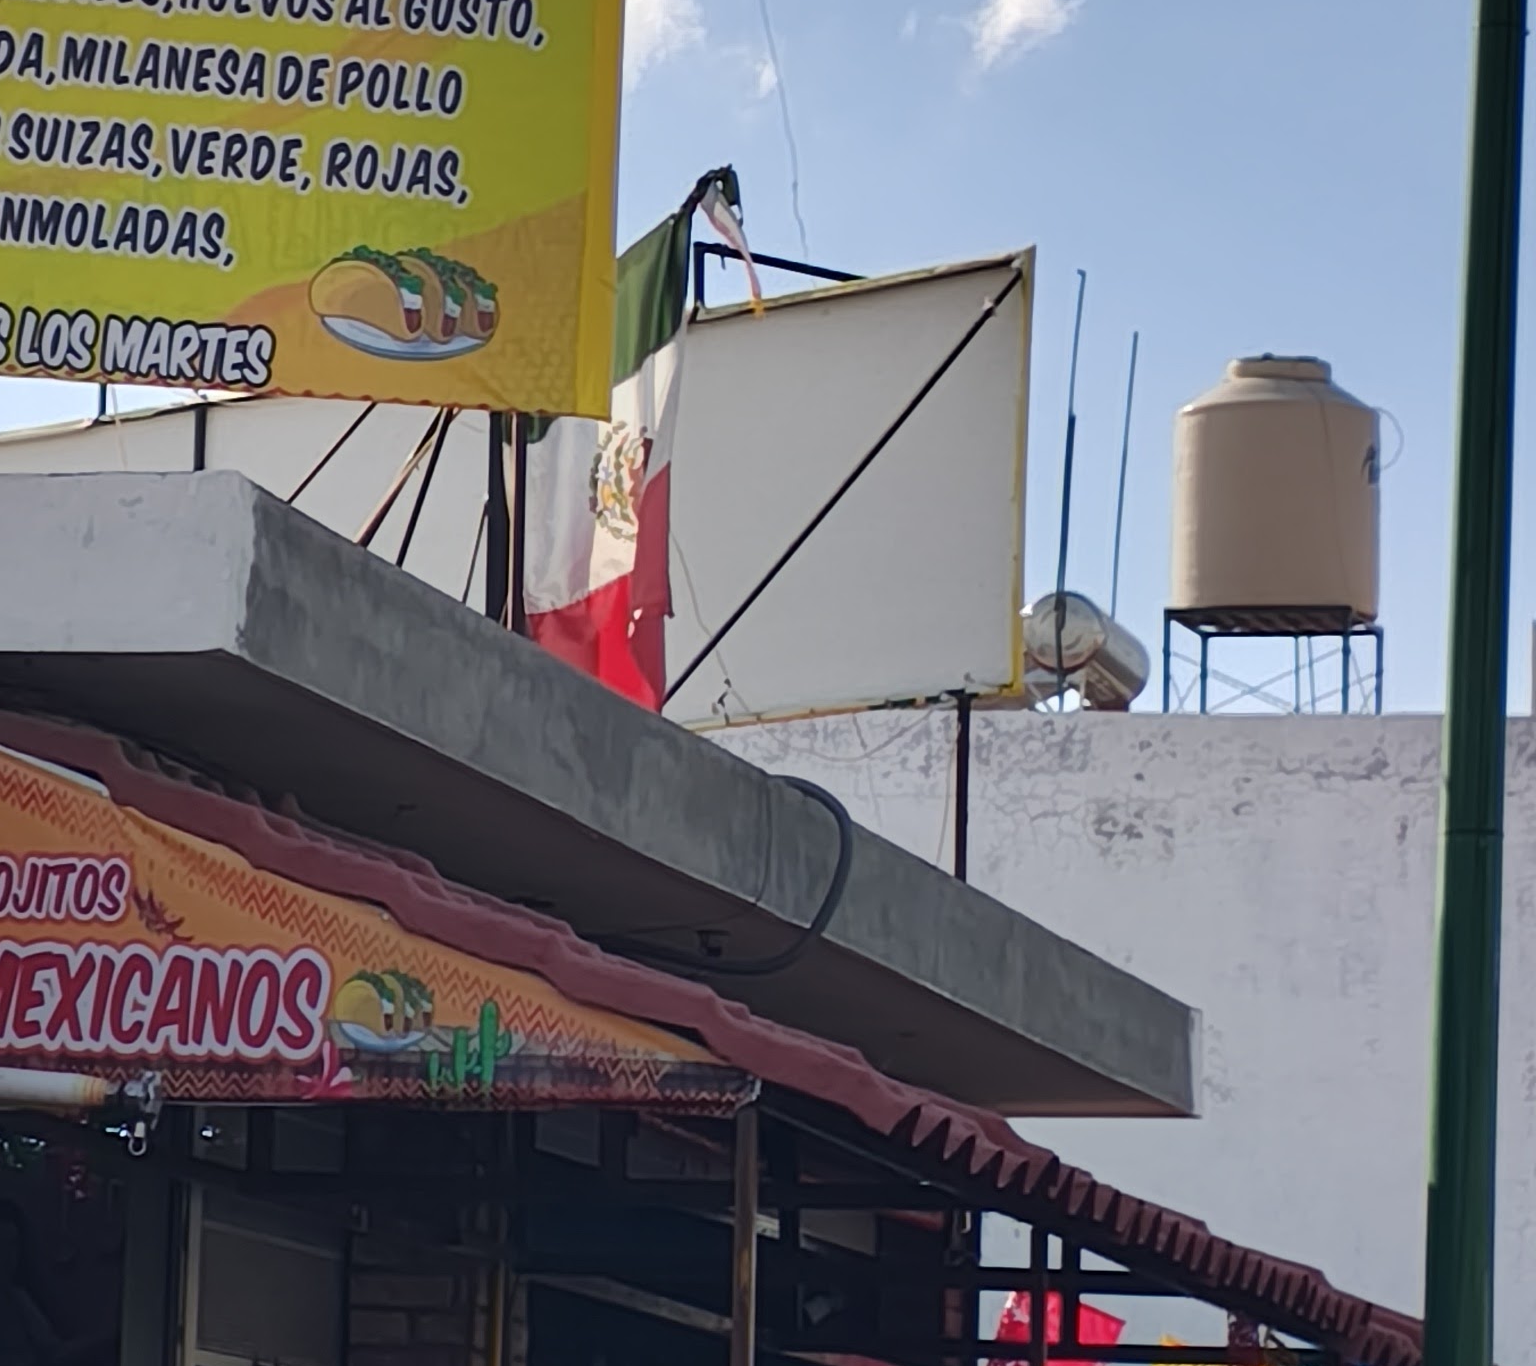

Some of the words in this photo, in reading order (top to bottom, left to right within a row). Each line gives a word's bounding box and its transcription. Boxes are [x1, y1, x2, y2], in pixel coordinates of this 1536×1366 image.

[277, 55, 331, 102] DE
[337, 61, 464, 116] POLLO
[326, 142, 468, 205] ROJAS,
[15, 307, 100, 374] LOS
[101, 315, 275, 386] MARTES
